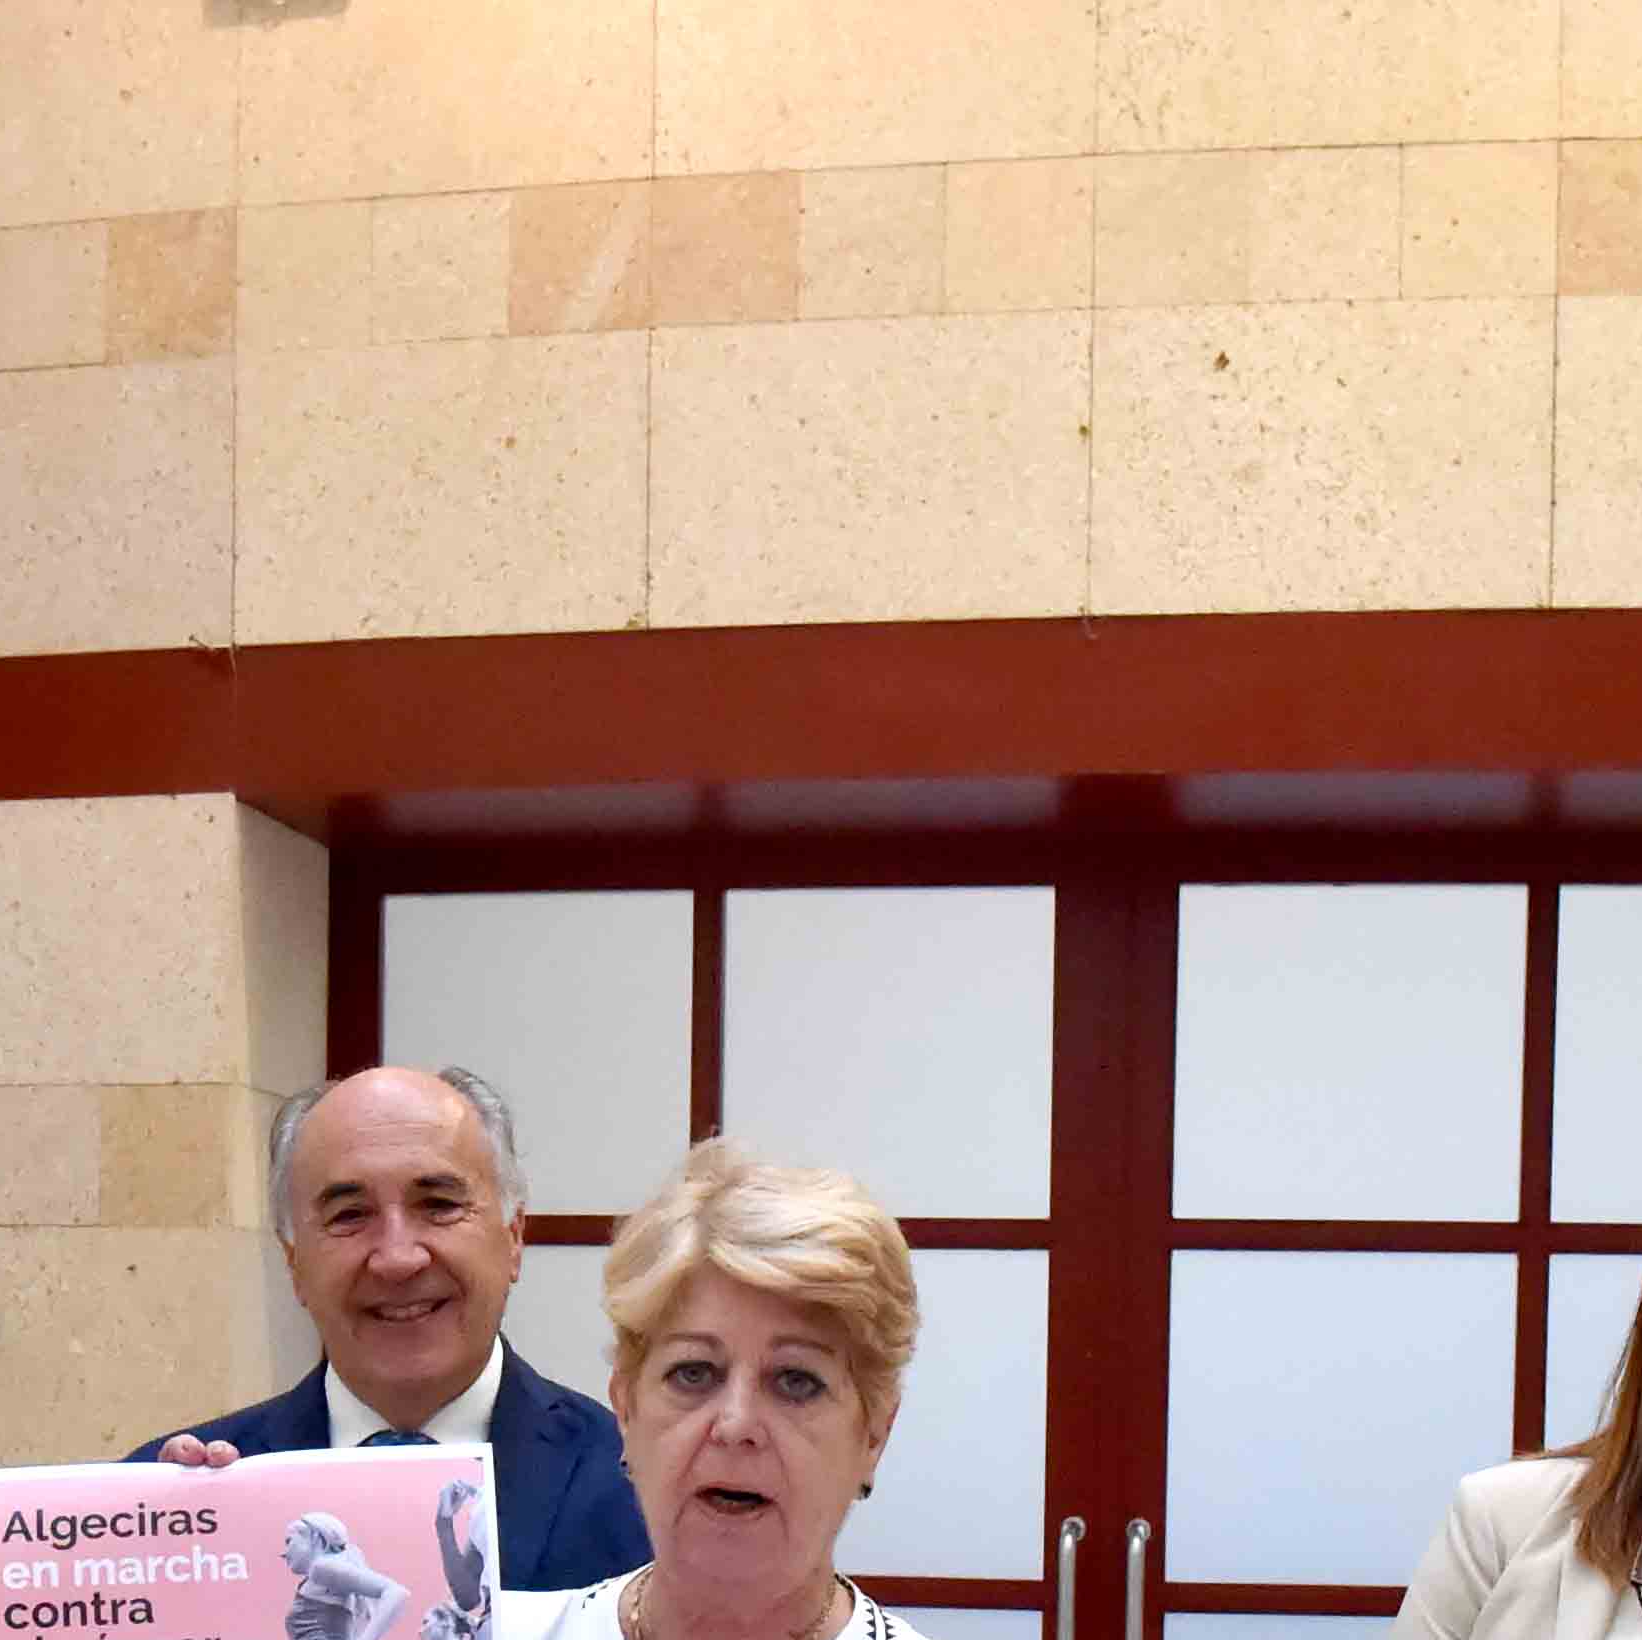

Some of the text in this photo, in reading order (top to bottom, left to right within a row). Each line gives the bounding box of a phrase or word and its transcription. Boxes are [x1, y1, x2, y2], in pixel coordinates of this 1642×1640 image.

[2, 1503, 218, 1550] Algeciras
[3, 1545, 249, 1590] en marcha
[4, 1592, 154, 1629] contra
